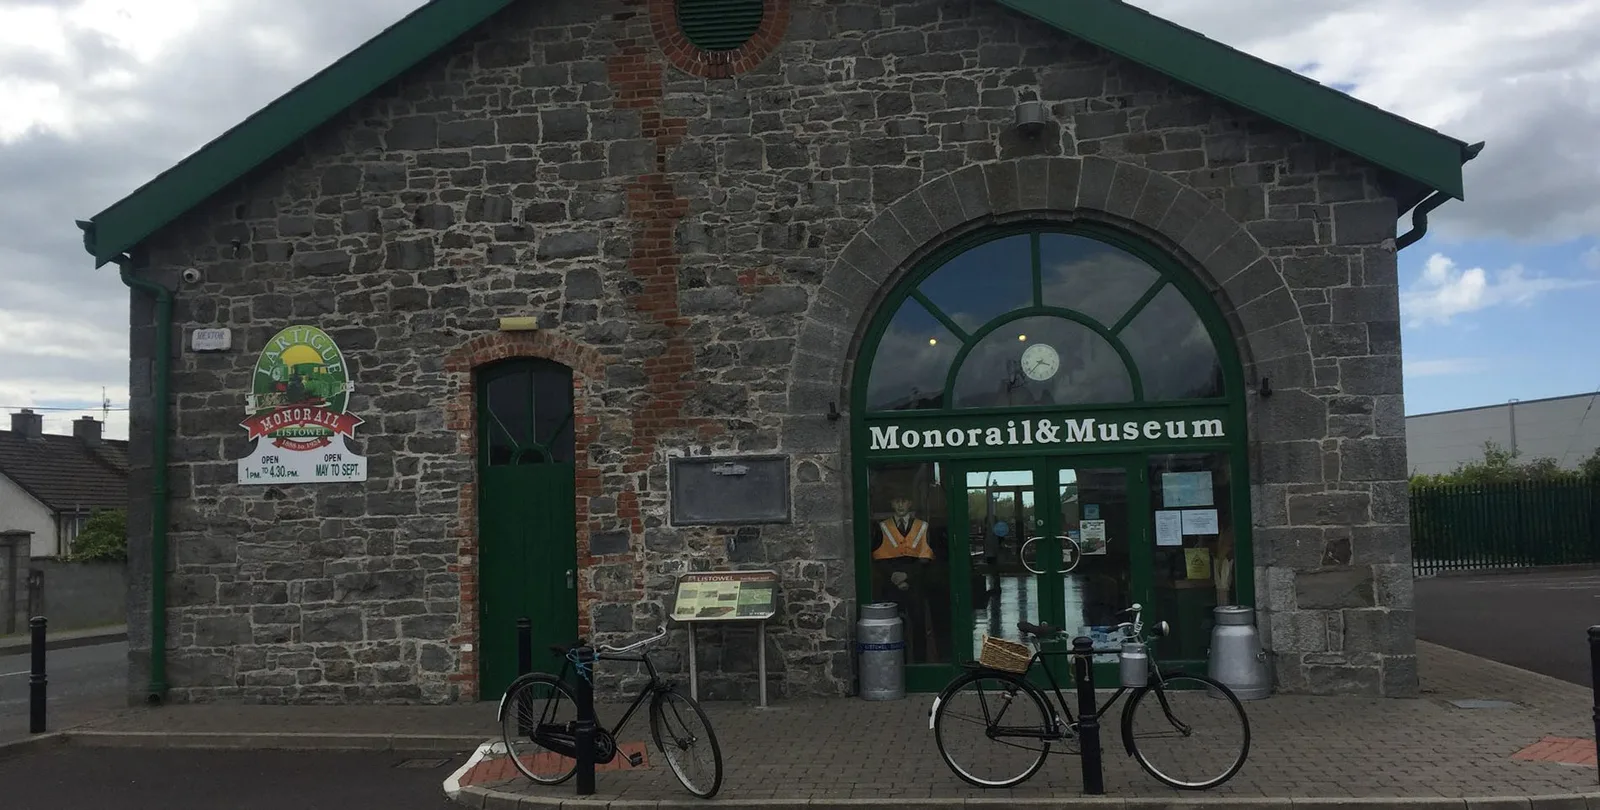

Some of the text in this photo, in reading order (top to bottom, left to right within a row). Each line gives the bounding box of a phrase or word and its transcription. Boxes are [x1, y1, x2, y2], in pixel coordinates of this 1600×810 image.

[258, 329, 342, 376] LARTIGUE
[260, 407, 340, 432] MONORAIL
[276, 428, 328, 437] LISTOWEL
[261, 455, 279, 464] OPEN
[323, 453, 342, 462] OPEN
[261, 466, 269, 474] TO
[315, 463, 360, 476] MAY TO SEPT.
